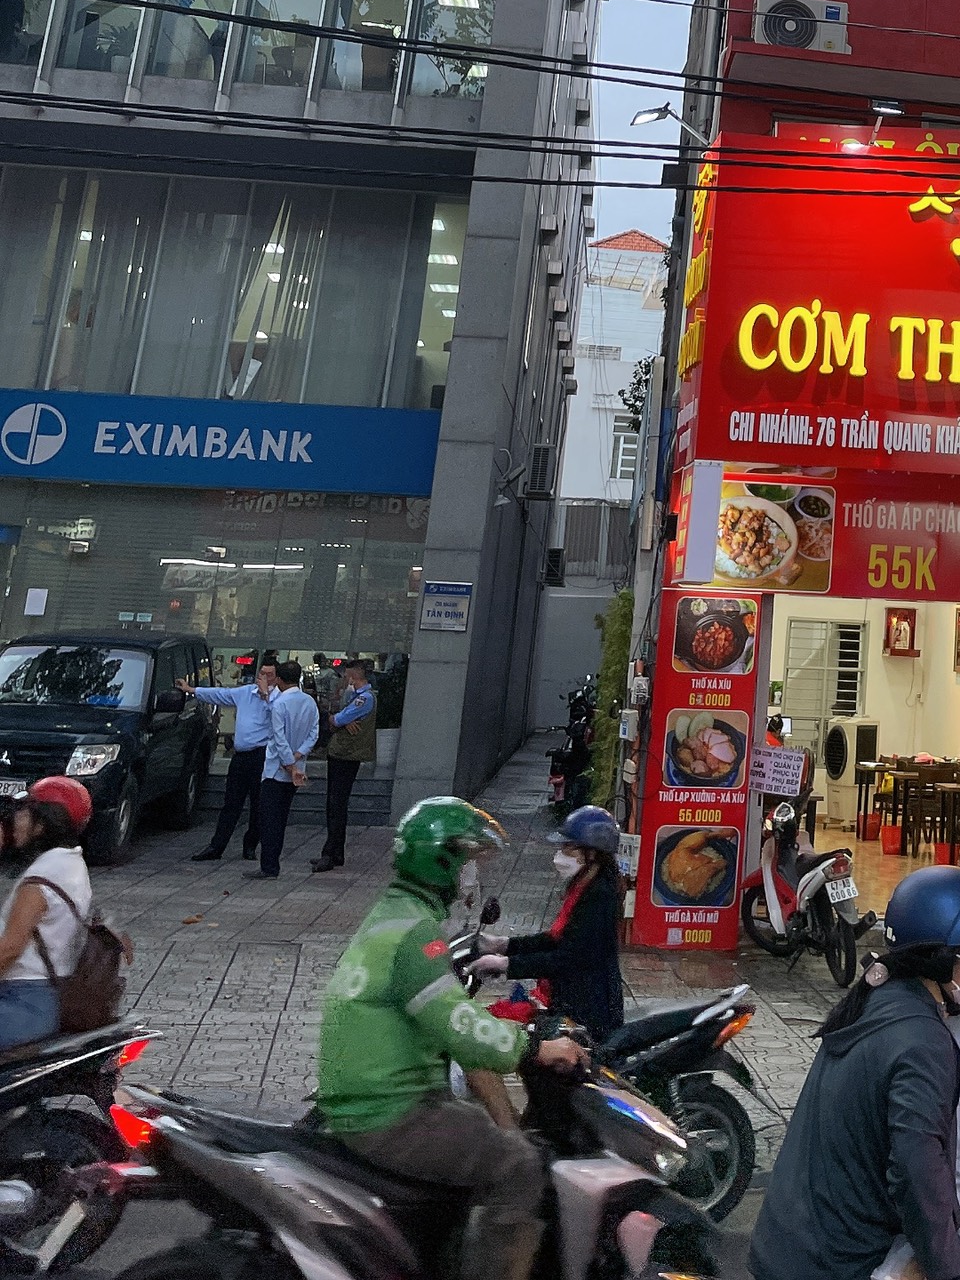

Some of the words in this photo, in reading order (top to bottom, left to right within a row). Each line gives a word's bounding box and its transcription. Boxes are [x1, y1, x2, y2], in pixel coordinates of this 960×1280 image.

[737, 298, 871, 376] CƠM
[93, 421, 313, 463] EXIMBANK
[729, 411, 755, 441] CHI
[758, 408, 813, 446] NHÁNH:
[816, 417, 836, 447] 76
[841, 410, 879, 450] TRẦN
[883, 420, 931, 454] QUANG
[842, 497, 876, 529] THỐ
[877, 501, 897, 530] GÀ
[901, 502, 922, 531] ÁP
[867, 544, 937, 591] 55K
